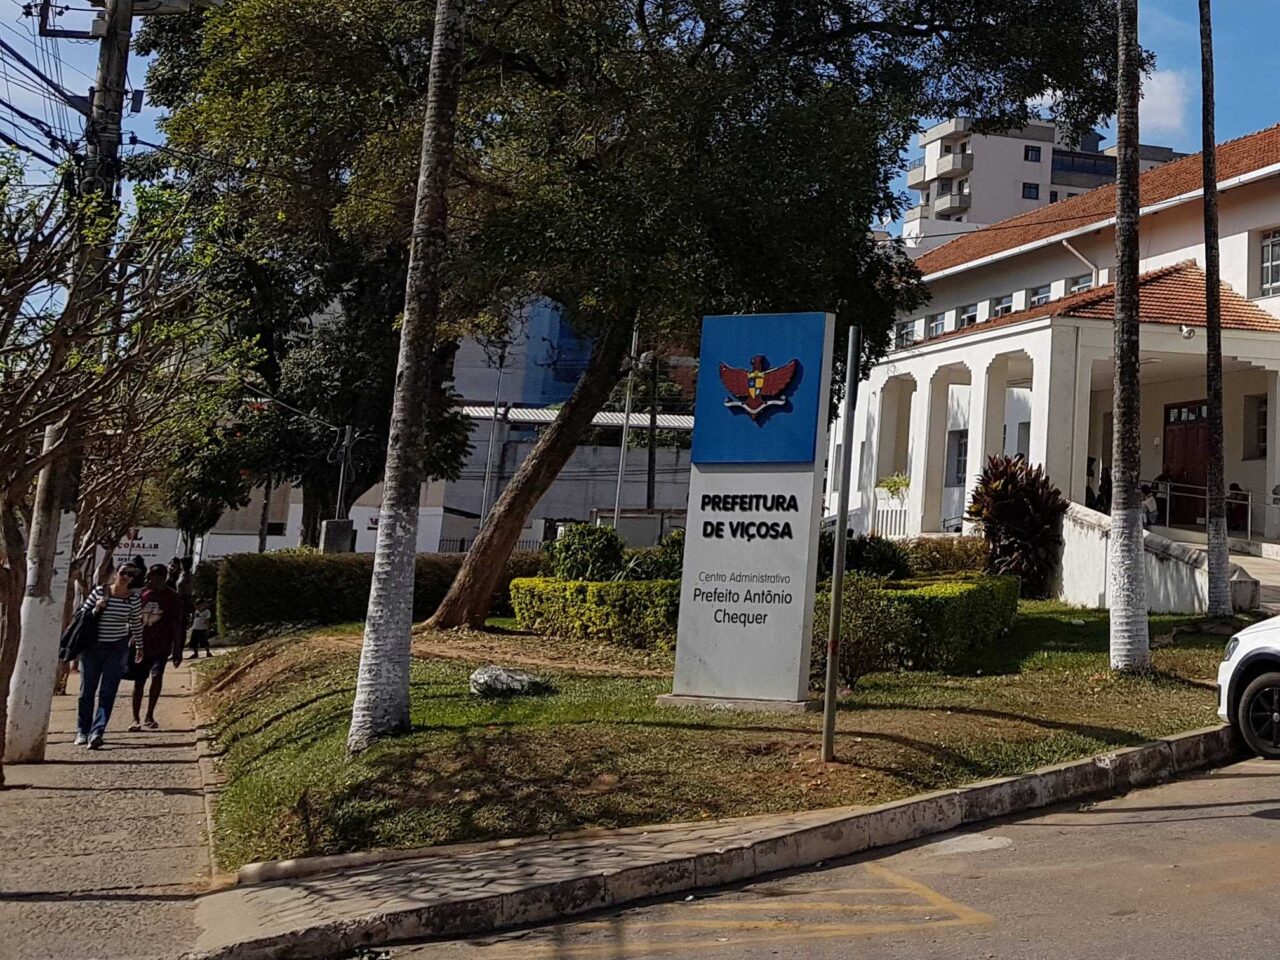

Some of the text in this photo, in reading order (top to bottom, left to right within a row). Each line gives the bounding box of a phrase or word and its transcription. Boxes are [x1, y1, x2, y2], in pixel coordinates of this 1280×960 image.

[701, 494, 799, 512] PREFEITURA
[702, 521, 793, 542] DE VIÇOSA
[698, 571, 791, 584] Centro Administrativo
[693, 587, 793, 604] Prefeito Antônio
[713, 609, 769, 628] Chequer
